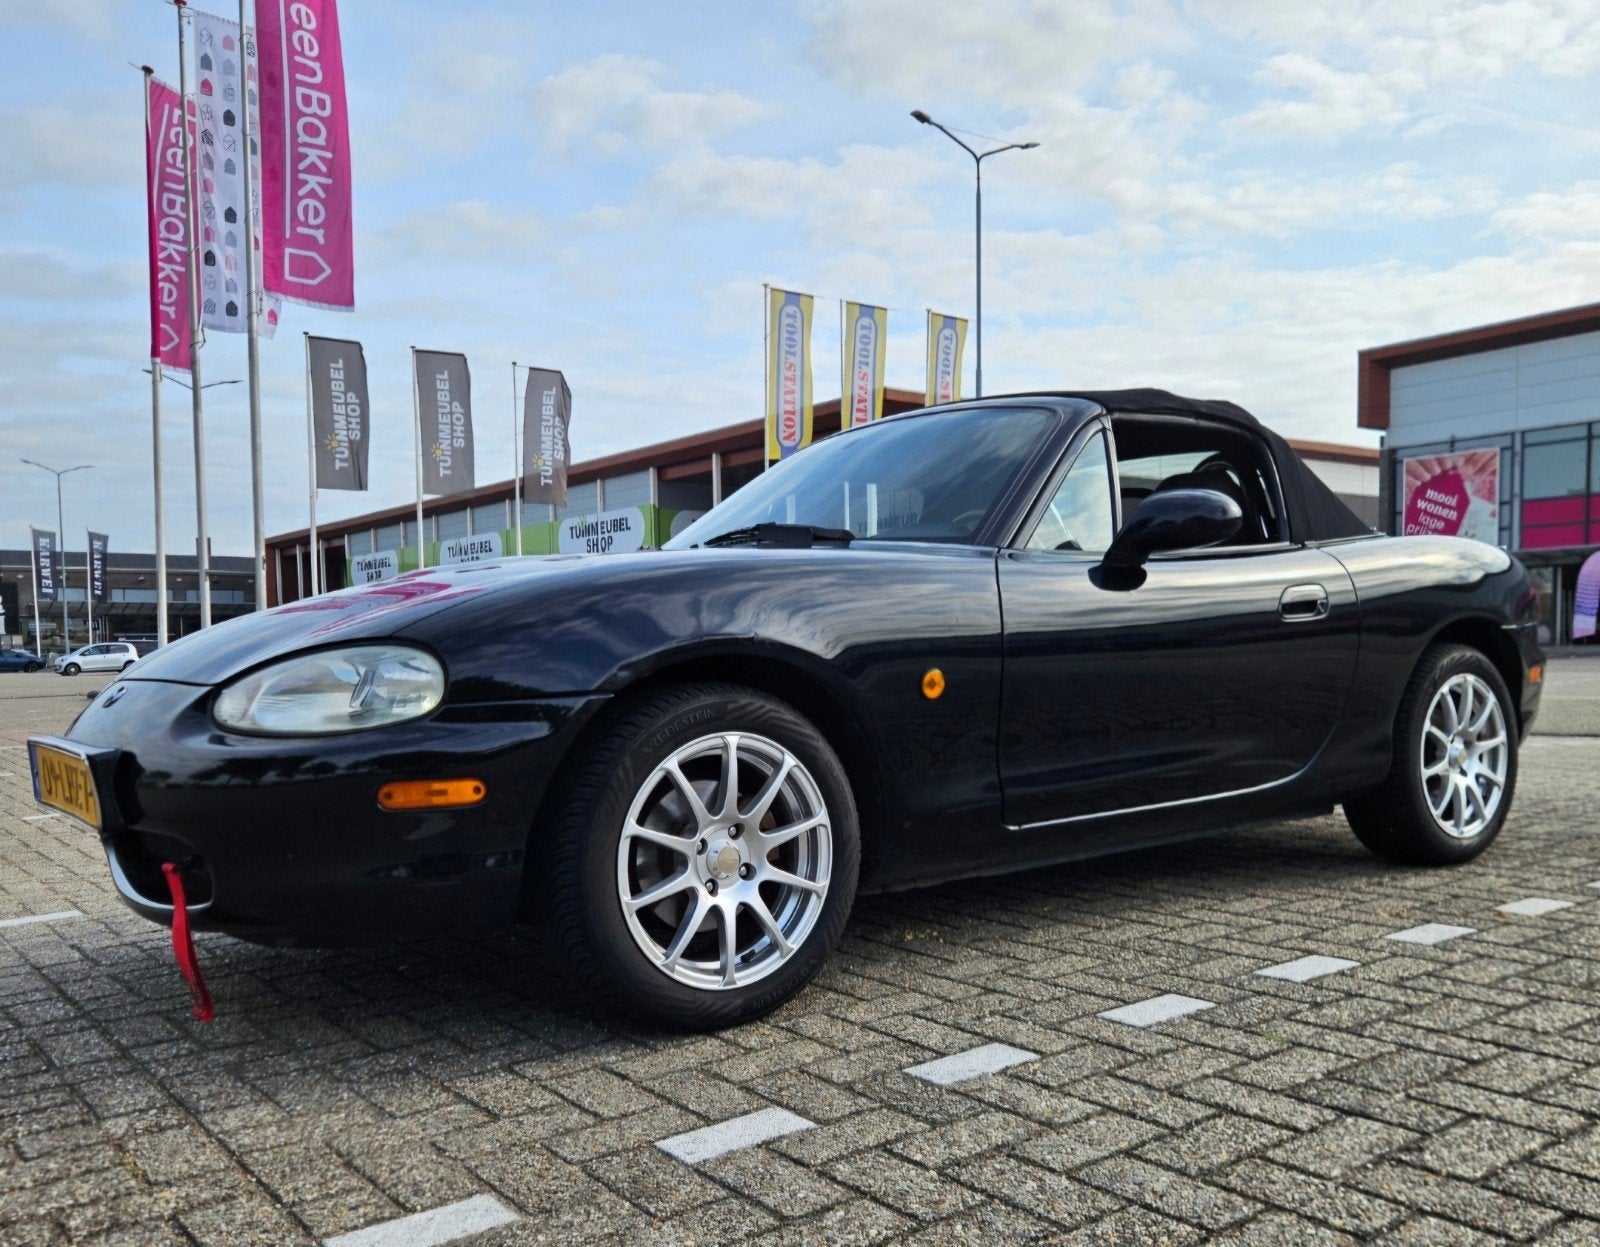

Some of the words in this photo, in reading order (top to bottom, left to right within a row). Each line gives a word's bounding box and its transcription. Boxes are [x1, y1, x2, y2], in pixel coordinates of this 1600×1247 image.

[782, 311, 797, 442] TOOLSTATION
[330, 358, 349, 470] TUINMEUBEL
[347, 392, 361, 441] SHOP
[437, 370, 452, 477] TUINMEUBEL
[452, 401, 465, 449] SHOP
[540, 387, 556, 486] TUINMEUBEL
[553, 416, 565, 461] SHOP
[1416, 498, 1458, 521] wonen
[1418, 511, 1445, 530] lage
[1425, 488, 1459, 507] mooi
[569, 516, 632, 540] TUINMEUBEL
[587, 535, 613, 553] SHOP
[39, 537, 54, 594] KARWEI
[93, 540, 103, 596] KARWEI
